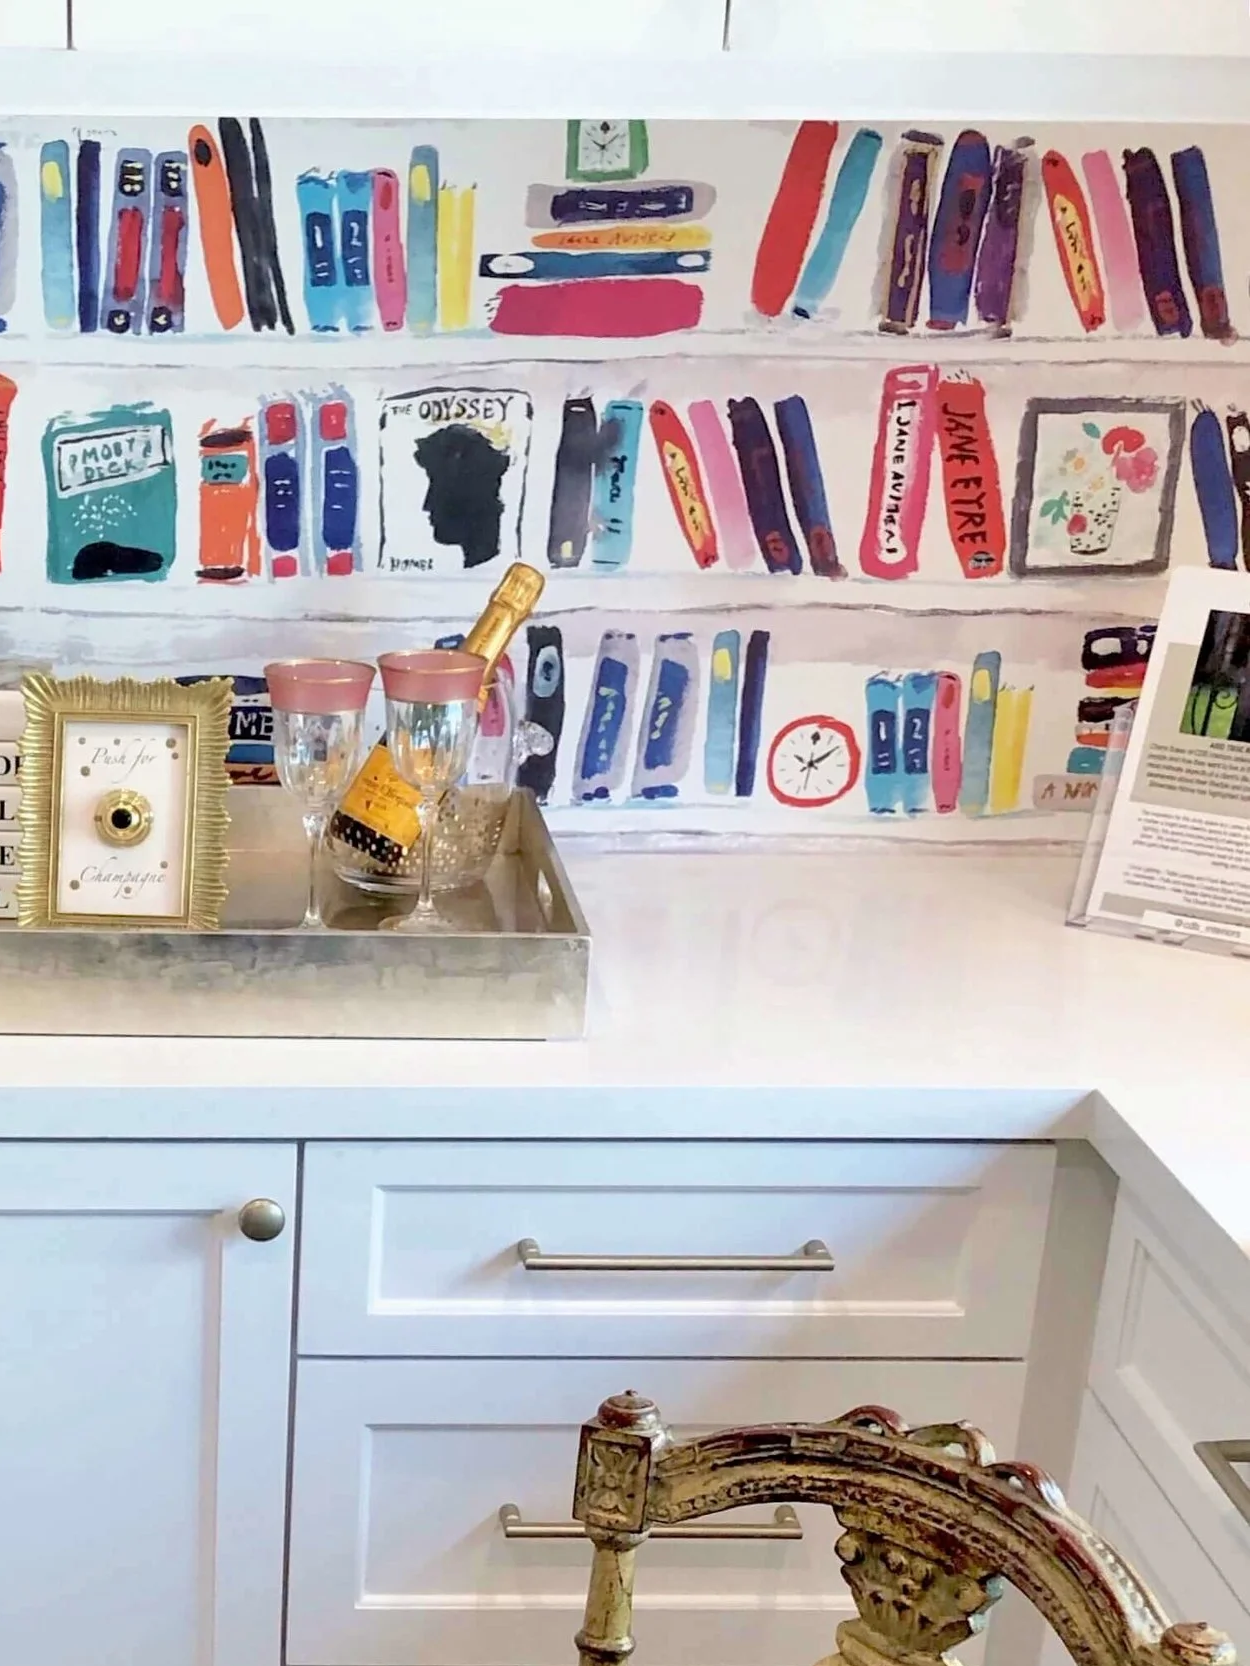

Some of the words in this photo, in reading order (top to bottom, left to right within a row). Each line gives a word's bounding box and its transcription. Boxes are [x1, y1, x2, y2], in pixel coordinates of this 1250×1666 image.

[391, 403, 413, 416] THE
[418, 395, 514, 422] ODYSSEY
[82, 437, 136, 465] MOBY
[942, 402, 980, 467] JANE
[951, 476, 988, 544] EYRE
[91, 739, 136, 764] Push
[112, 738, 158, 784] for
[80, 856, 167, 899] Champagne
